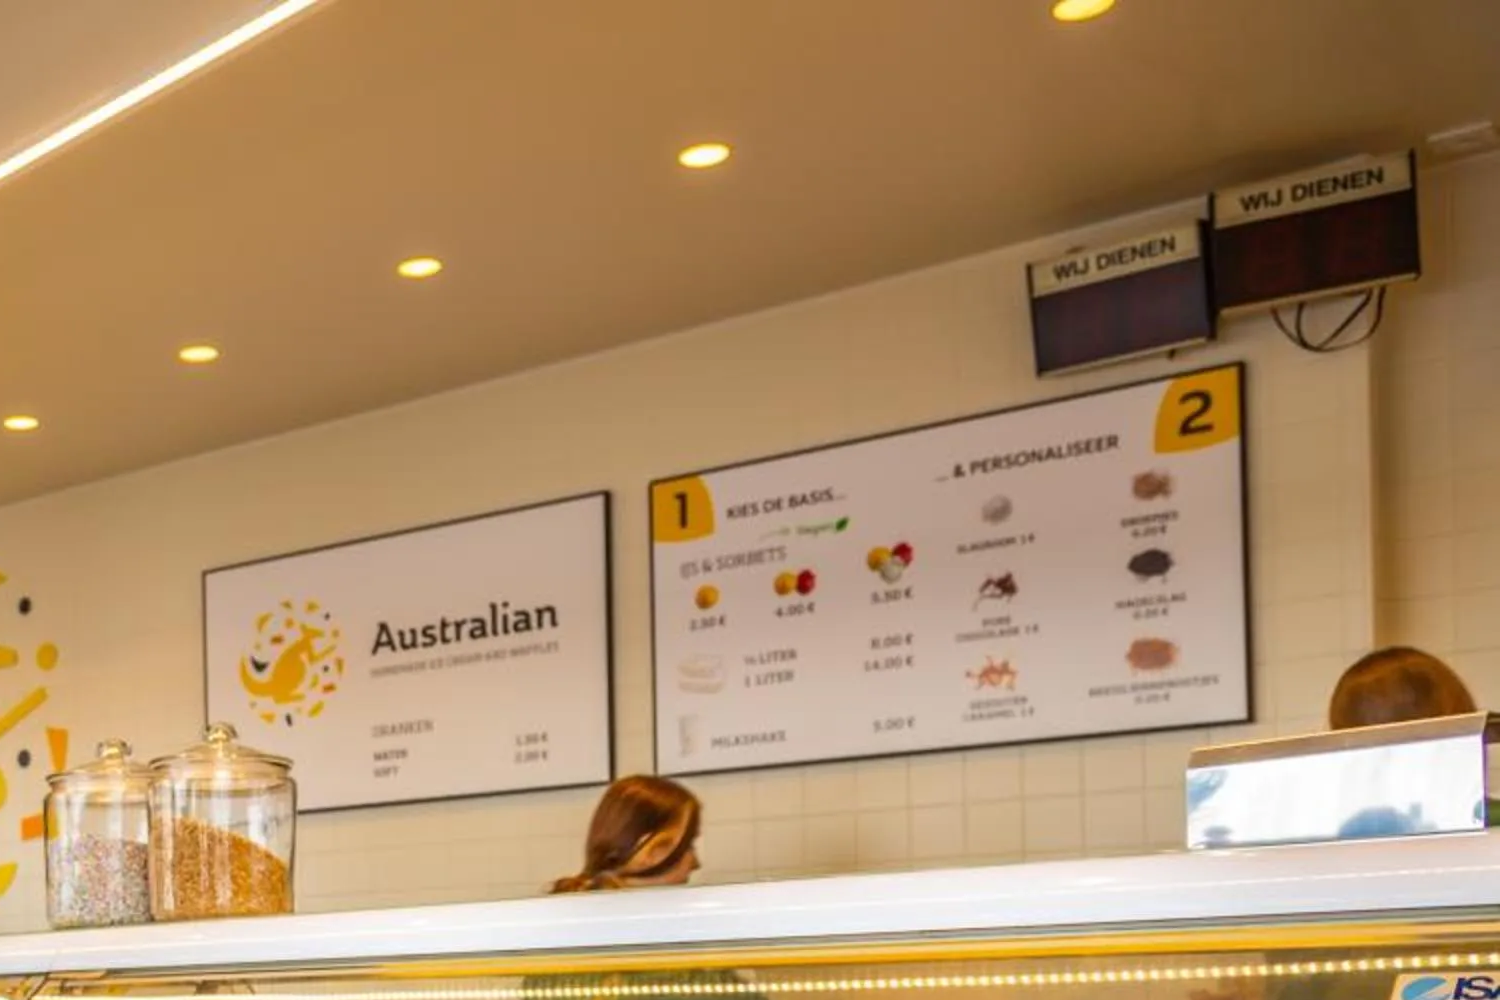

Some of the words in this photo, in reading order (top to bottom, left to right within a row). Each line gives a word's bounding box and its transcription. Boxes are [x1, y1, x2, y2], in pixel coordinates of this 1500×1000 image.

[1240, 189, 1282, 212] WIJ
[1290, 167, 1384, 202] DIENEN
[1053, 257, 1088, 281] WIJ
[1095, 236, 1176, 270] DIENEN
[1178, 389, 1214, 436] 2
[953, 464, 966, 479] &
[970, 435, 1119, 476] PERSONALISEER
[674, 492, 688, 529] 1
[726, 504, 760, 520] KIES
[763, 498, 783, 513] DE
[702, 558, 714, 572] &
[716, 546, 787, 570] SORBETS
[371, 600, 559, 657] Australian
[1453, 976, 1500, 1000] IS
